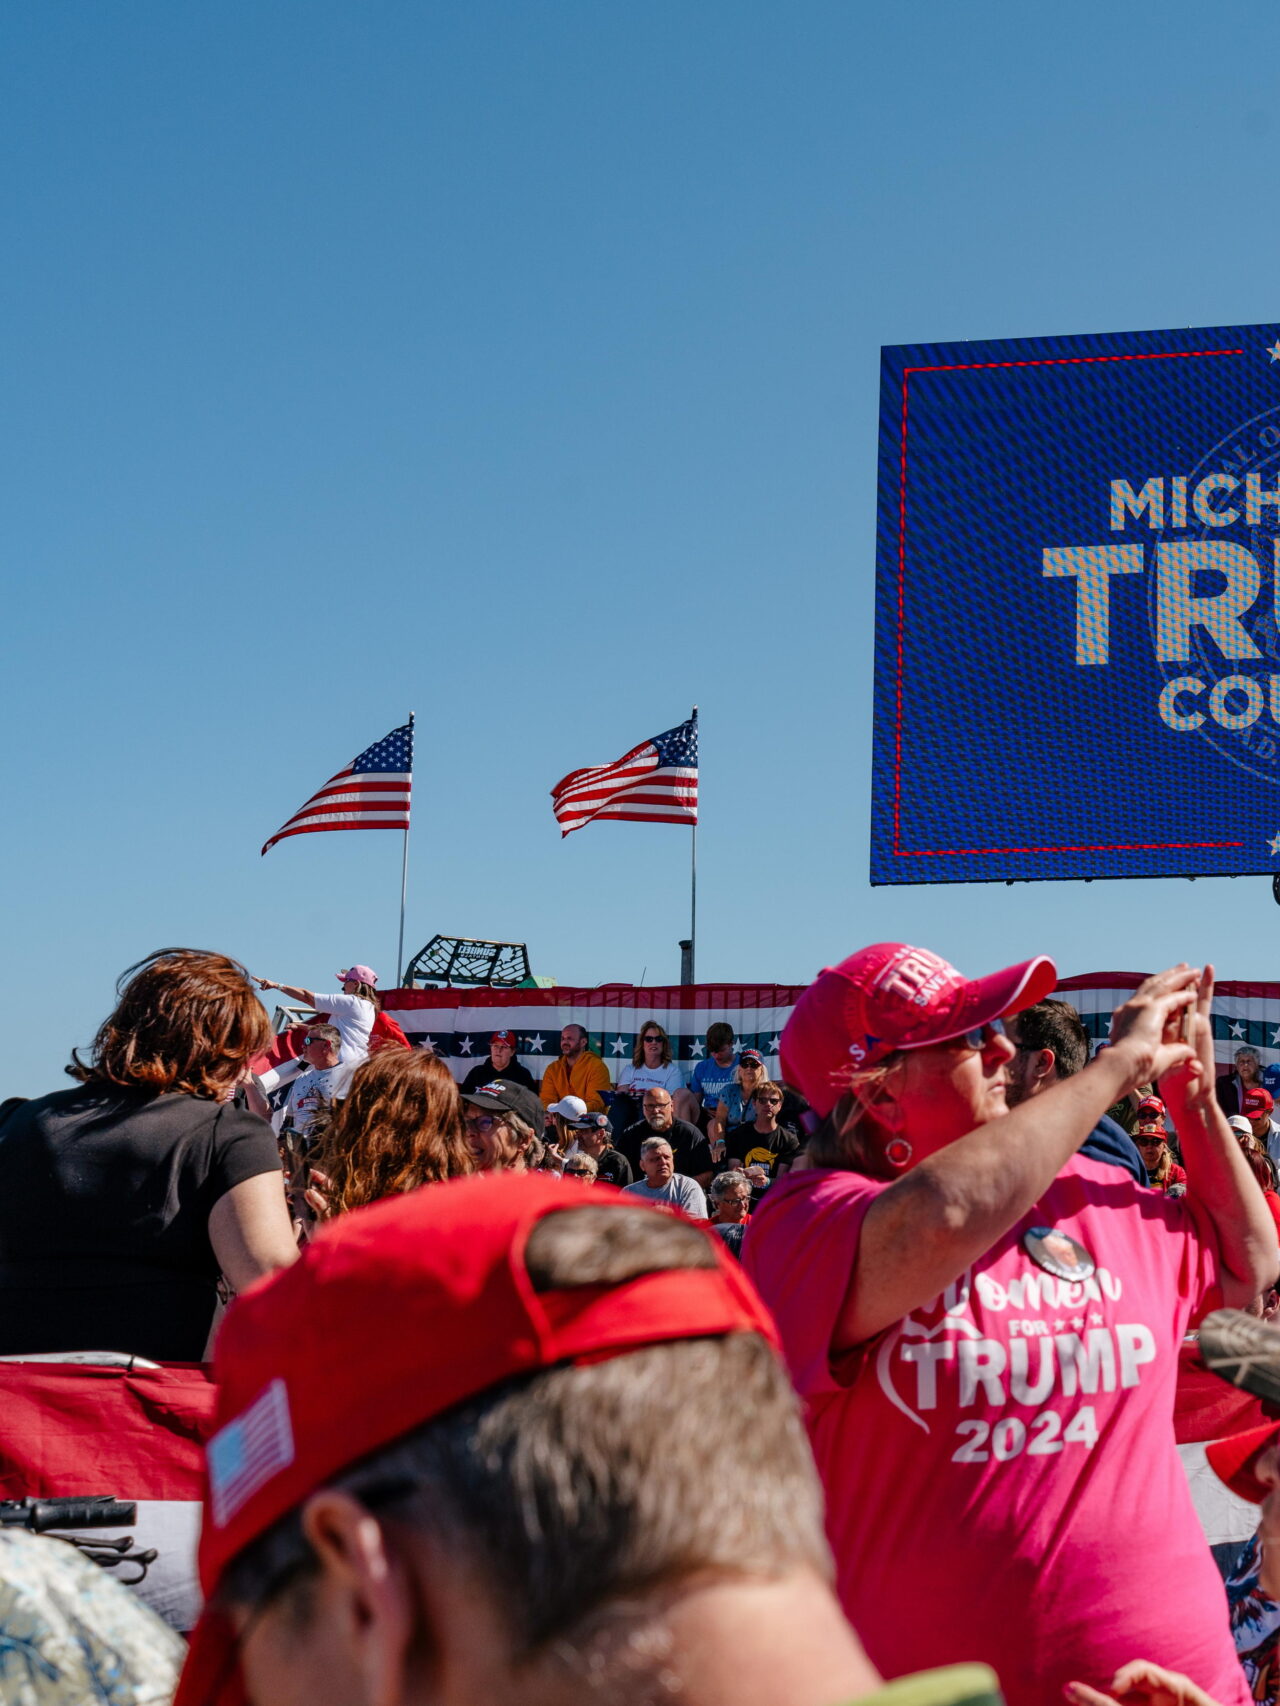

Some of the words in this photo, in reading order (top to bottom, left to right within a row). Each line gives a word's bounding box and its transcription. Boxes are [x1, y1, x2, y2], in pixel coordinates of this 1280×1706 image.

[1008, 1319, 1048, 1336] FOR
[901, 1323, 1157, 1410] TRUMP
[951, 1406, 1099, 1463] 2024
